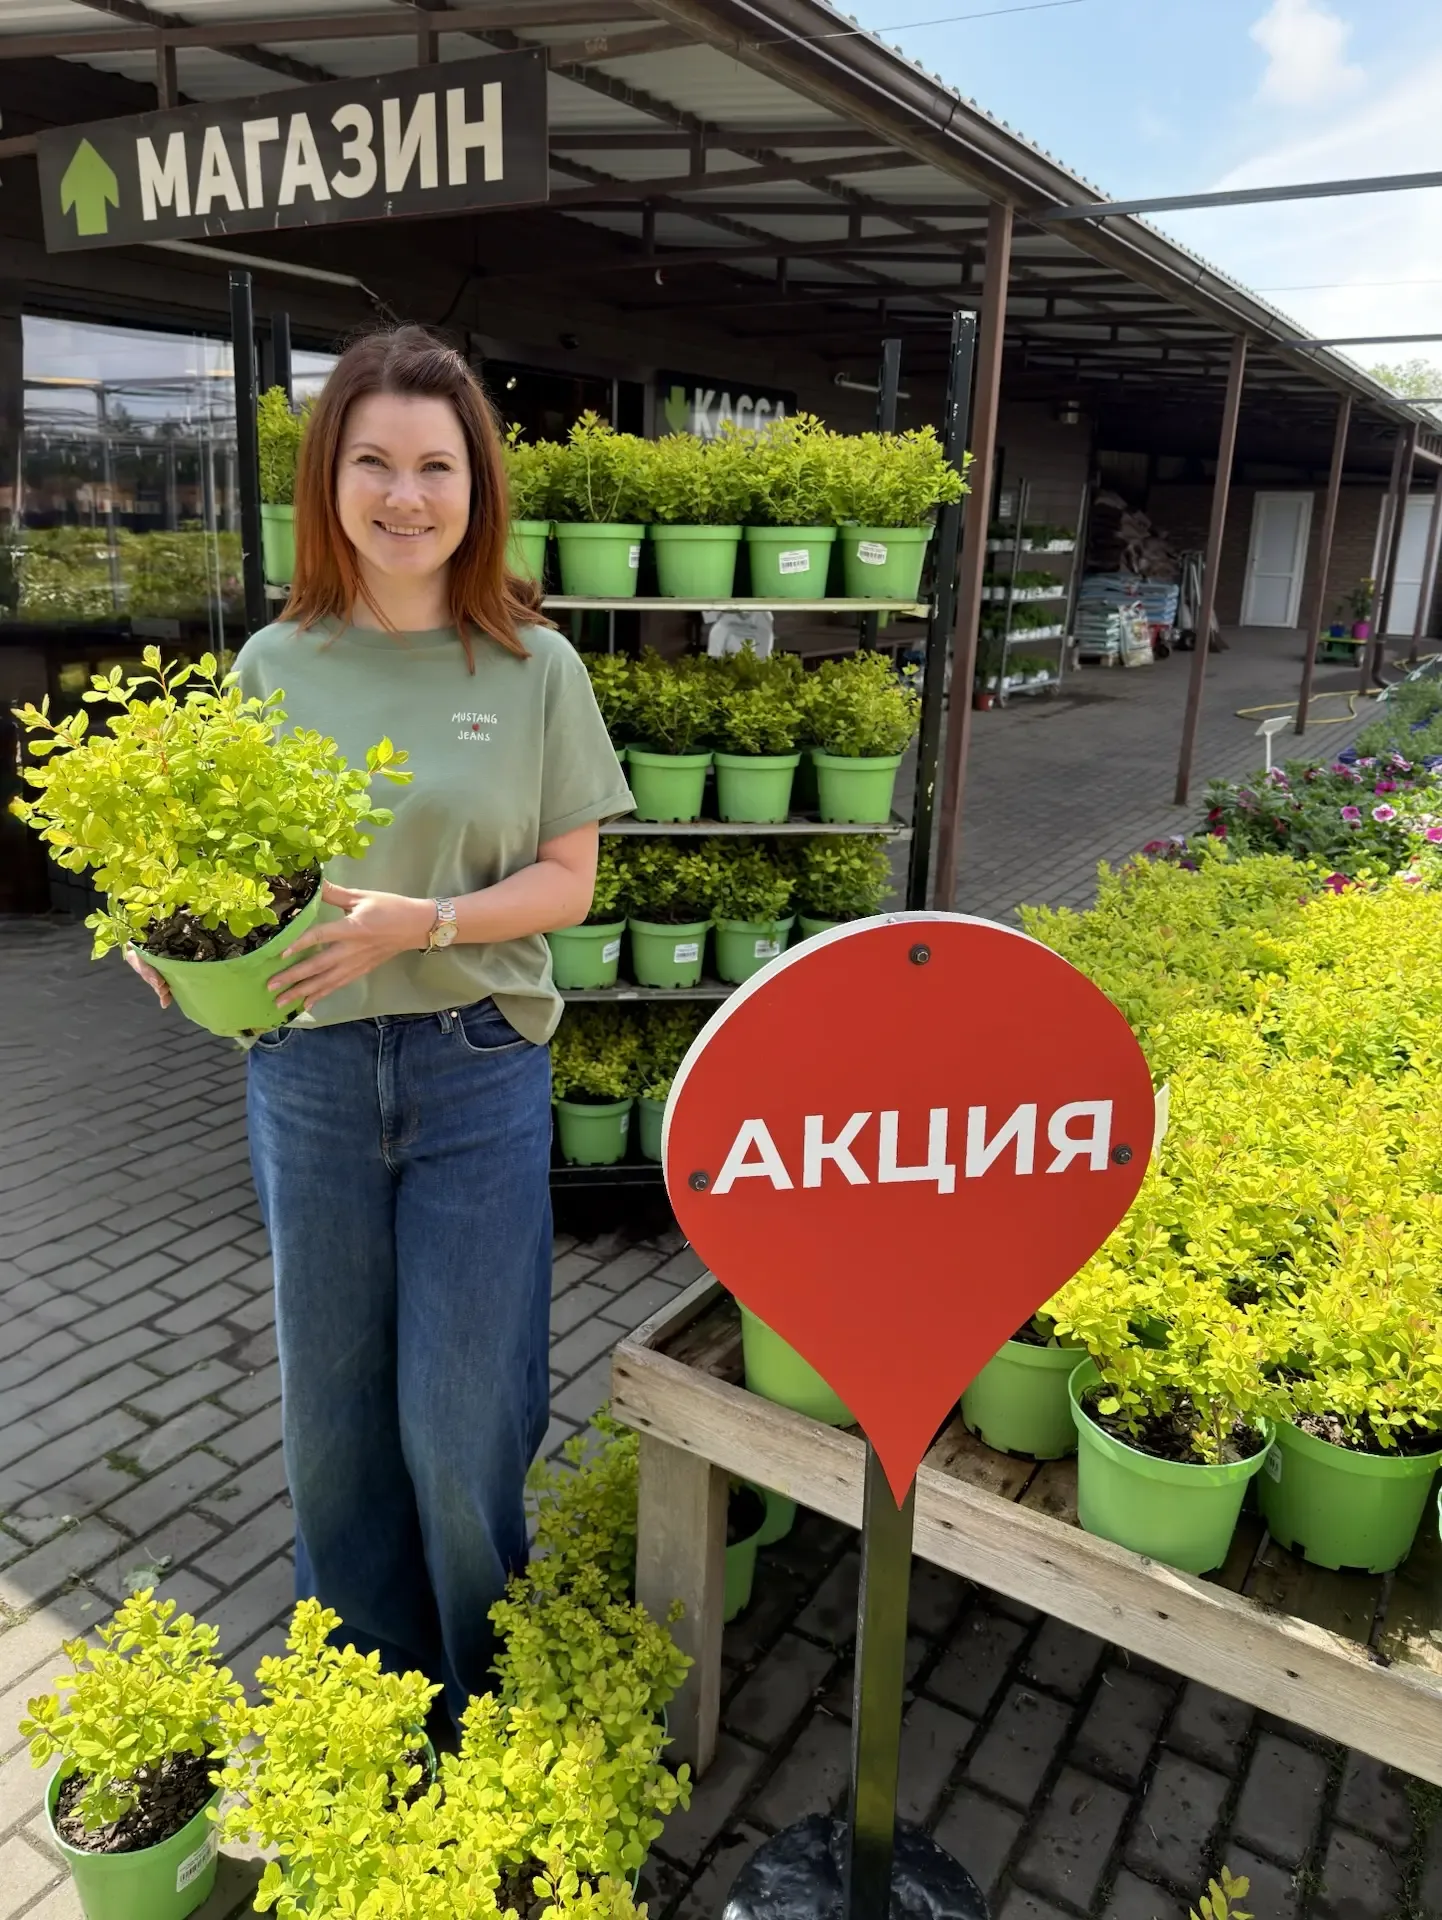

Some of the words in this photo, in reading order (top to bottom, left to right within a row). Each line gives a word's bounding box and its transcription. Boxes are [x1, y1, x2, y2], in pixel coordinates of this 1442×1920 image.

[136, 82, 504, 221] МАГАЗИН
[451, 712, 497, 724] MUSTANG
[457, 730, 490, 741] JEANS
[710, 1100, 1113, 1195] АКЦИЯ
